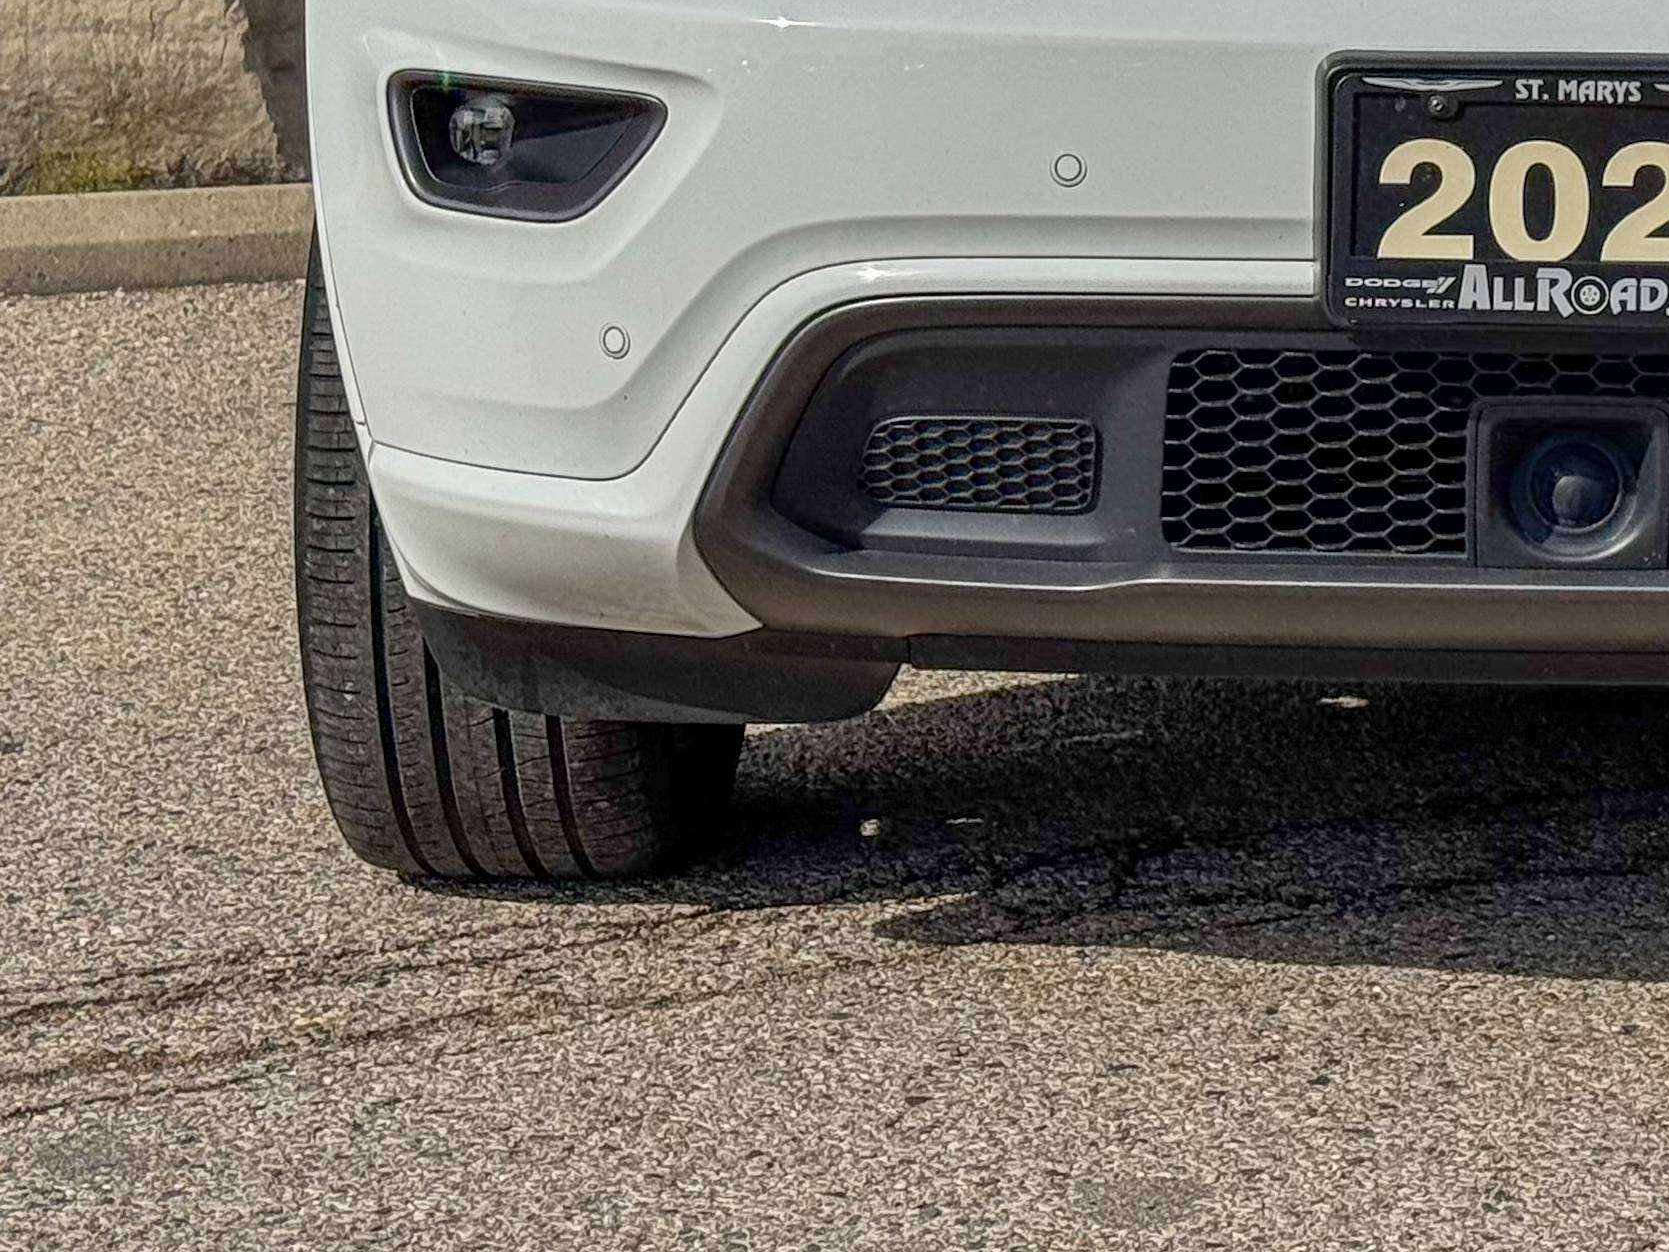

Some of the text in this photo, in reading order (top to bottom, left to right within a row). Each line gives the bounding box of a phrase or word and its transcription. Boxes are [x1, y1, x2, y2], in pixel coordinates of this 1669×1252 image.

[1514, 78, 1642, 104] ST. MARYS
[1344, 277, 1440, 293] DODGE
[1344, 296, 1456, 310] CHRYSLER
